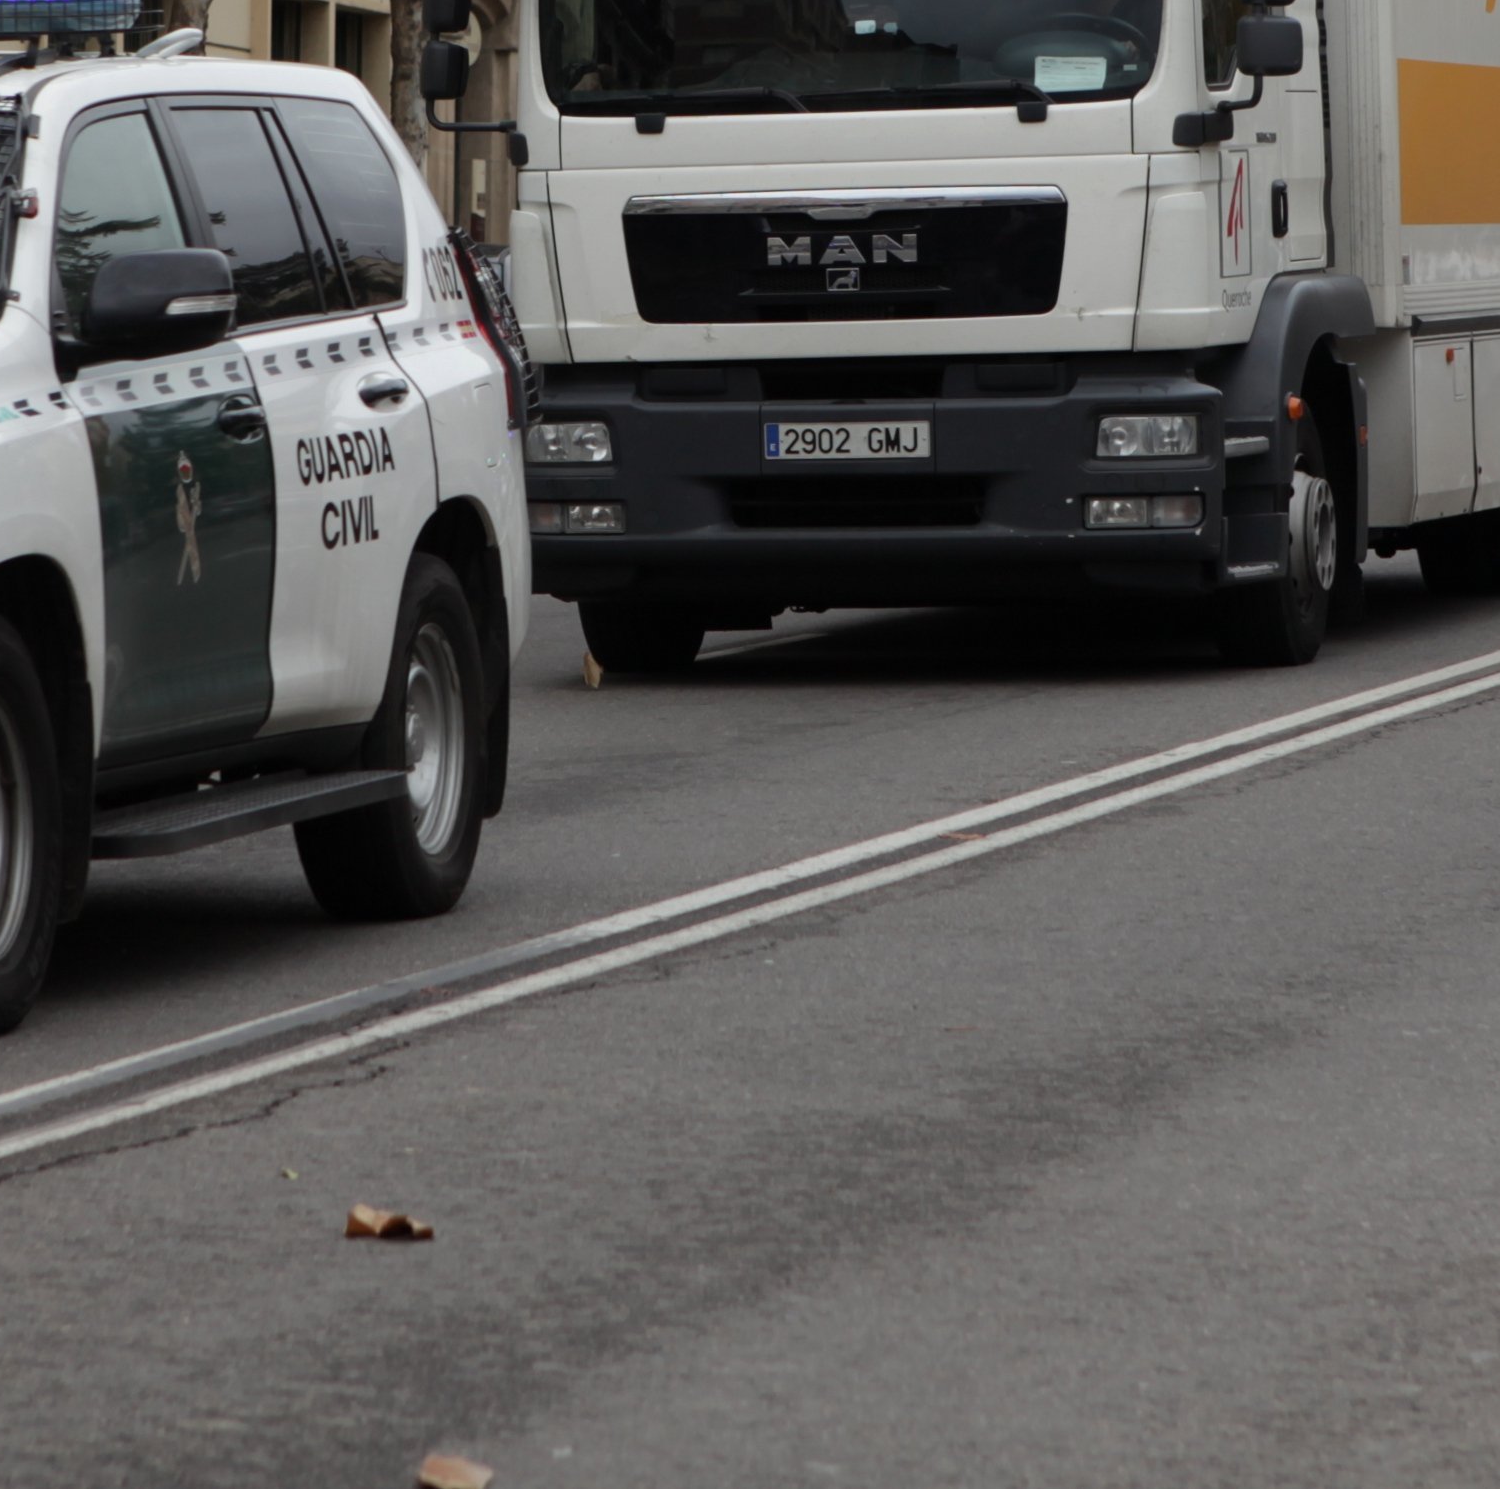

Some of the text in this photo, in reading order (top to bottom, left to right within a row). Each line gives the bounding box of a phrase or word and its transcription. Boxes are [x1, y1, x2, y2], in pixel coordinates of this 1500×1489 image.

[766, 232, 918, 266] MAN
[297, 427, 396, 486] GUARDIA
[784, 427, 851, 455] 2902
[867, 427, 918, 454] GMJ
[321, 495, 380, 550] CIVIL
